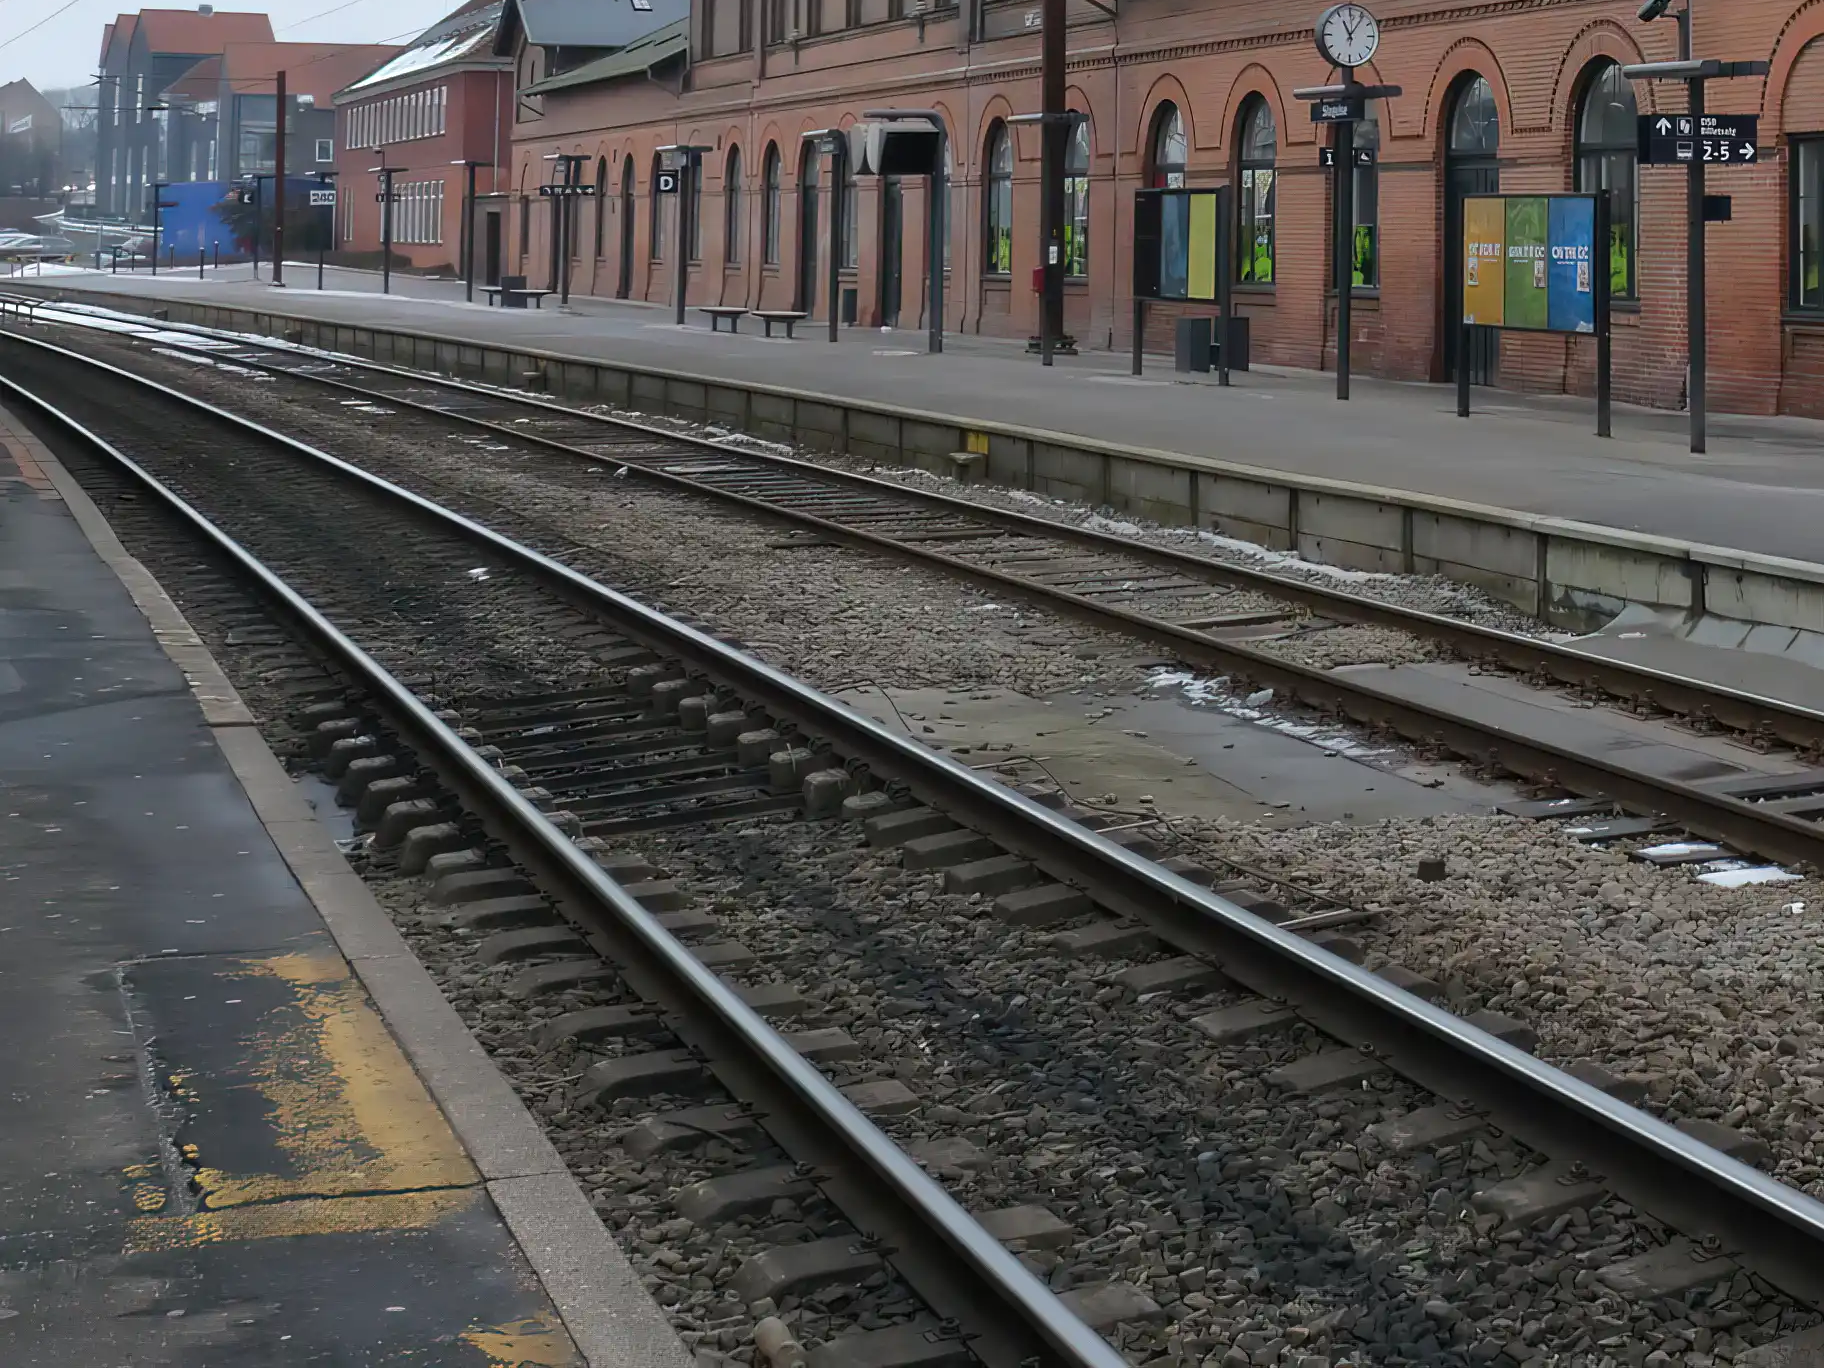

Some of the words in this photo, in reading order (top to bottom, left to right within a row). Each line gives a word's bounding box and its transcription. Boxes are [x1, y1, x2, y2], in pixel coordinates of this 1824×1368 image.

[1325, 153, 1334, 165] 1
[1702, 145, 1730, 161] 2-5
[659, 175, 674, 191] D
